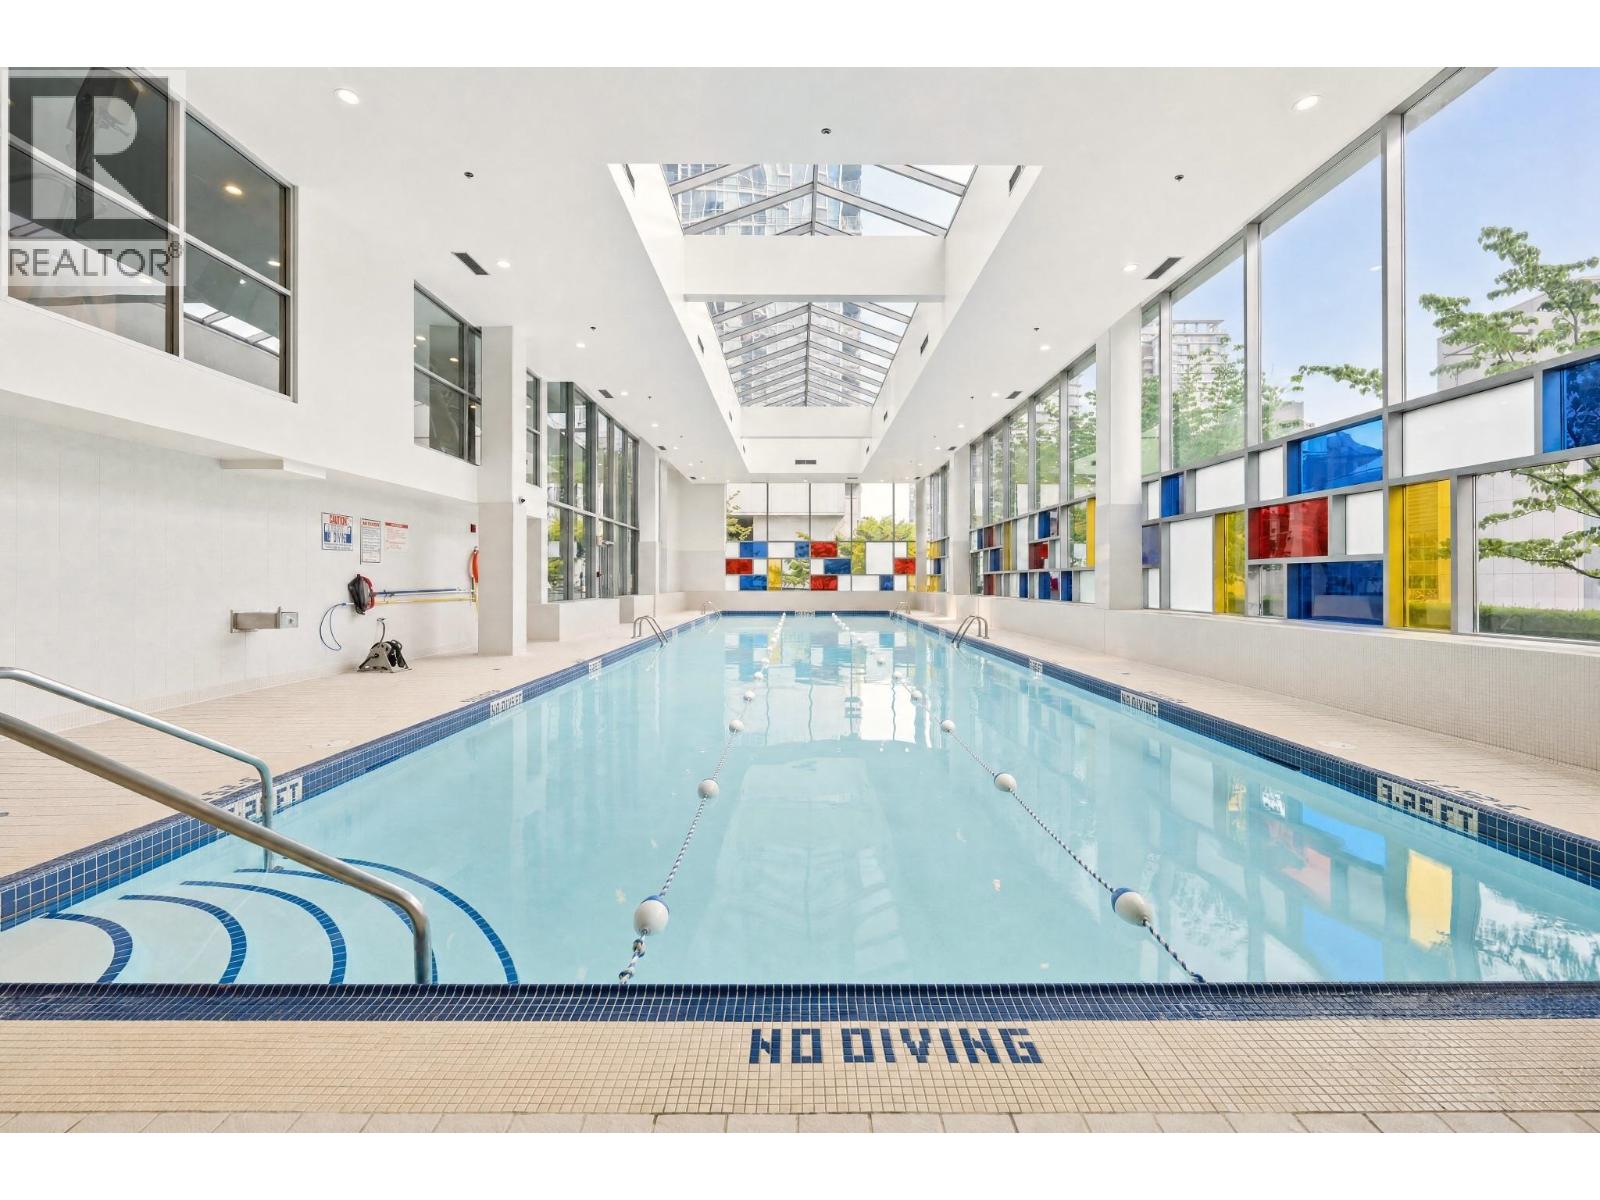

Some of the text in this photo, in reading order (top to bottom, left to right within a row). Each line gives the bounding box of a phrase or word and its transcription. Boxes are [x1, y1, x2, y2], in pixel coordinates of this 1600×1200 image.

[1133, 695, 1158, 716] DIVING
[276, 782, 299, 809] FT
[1441, 803, 1473, 832] FT
[749, 1028, 1043, 1063] NO DIVING
